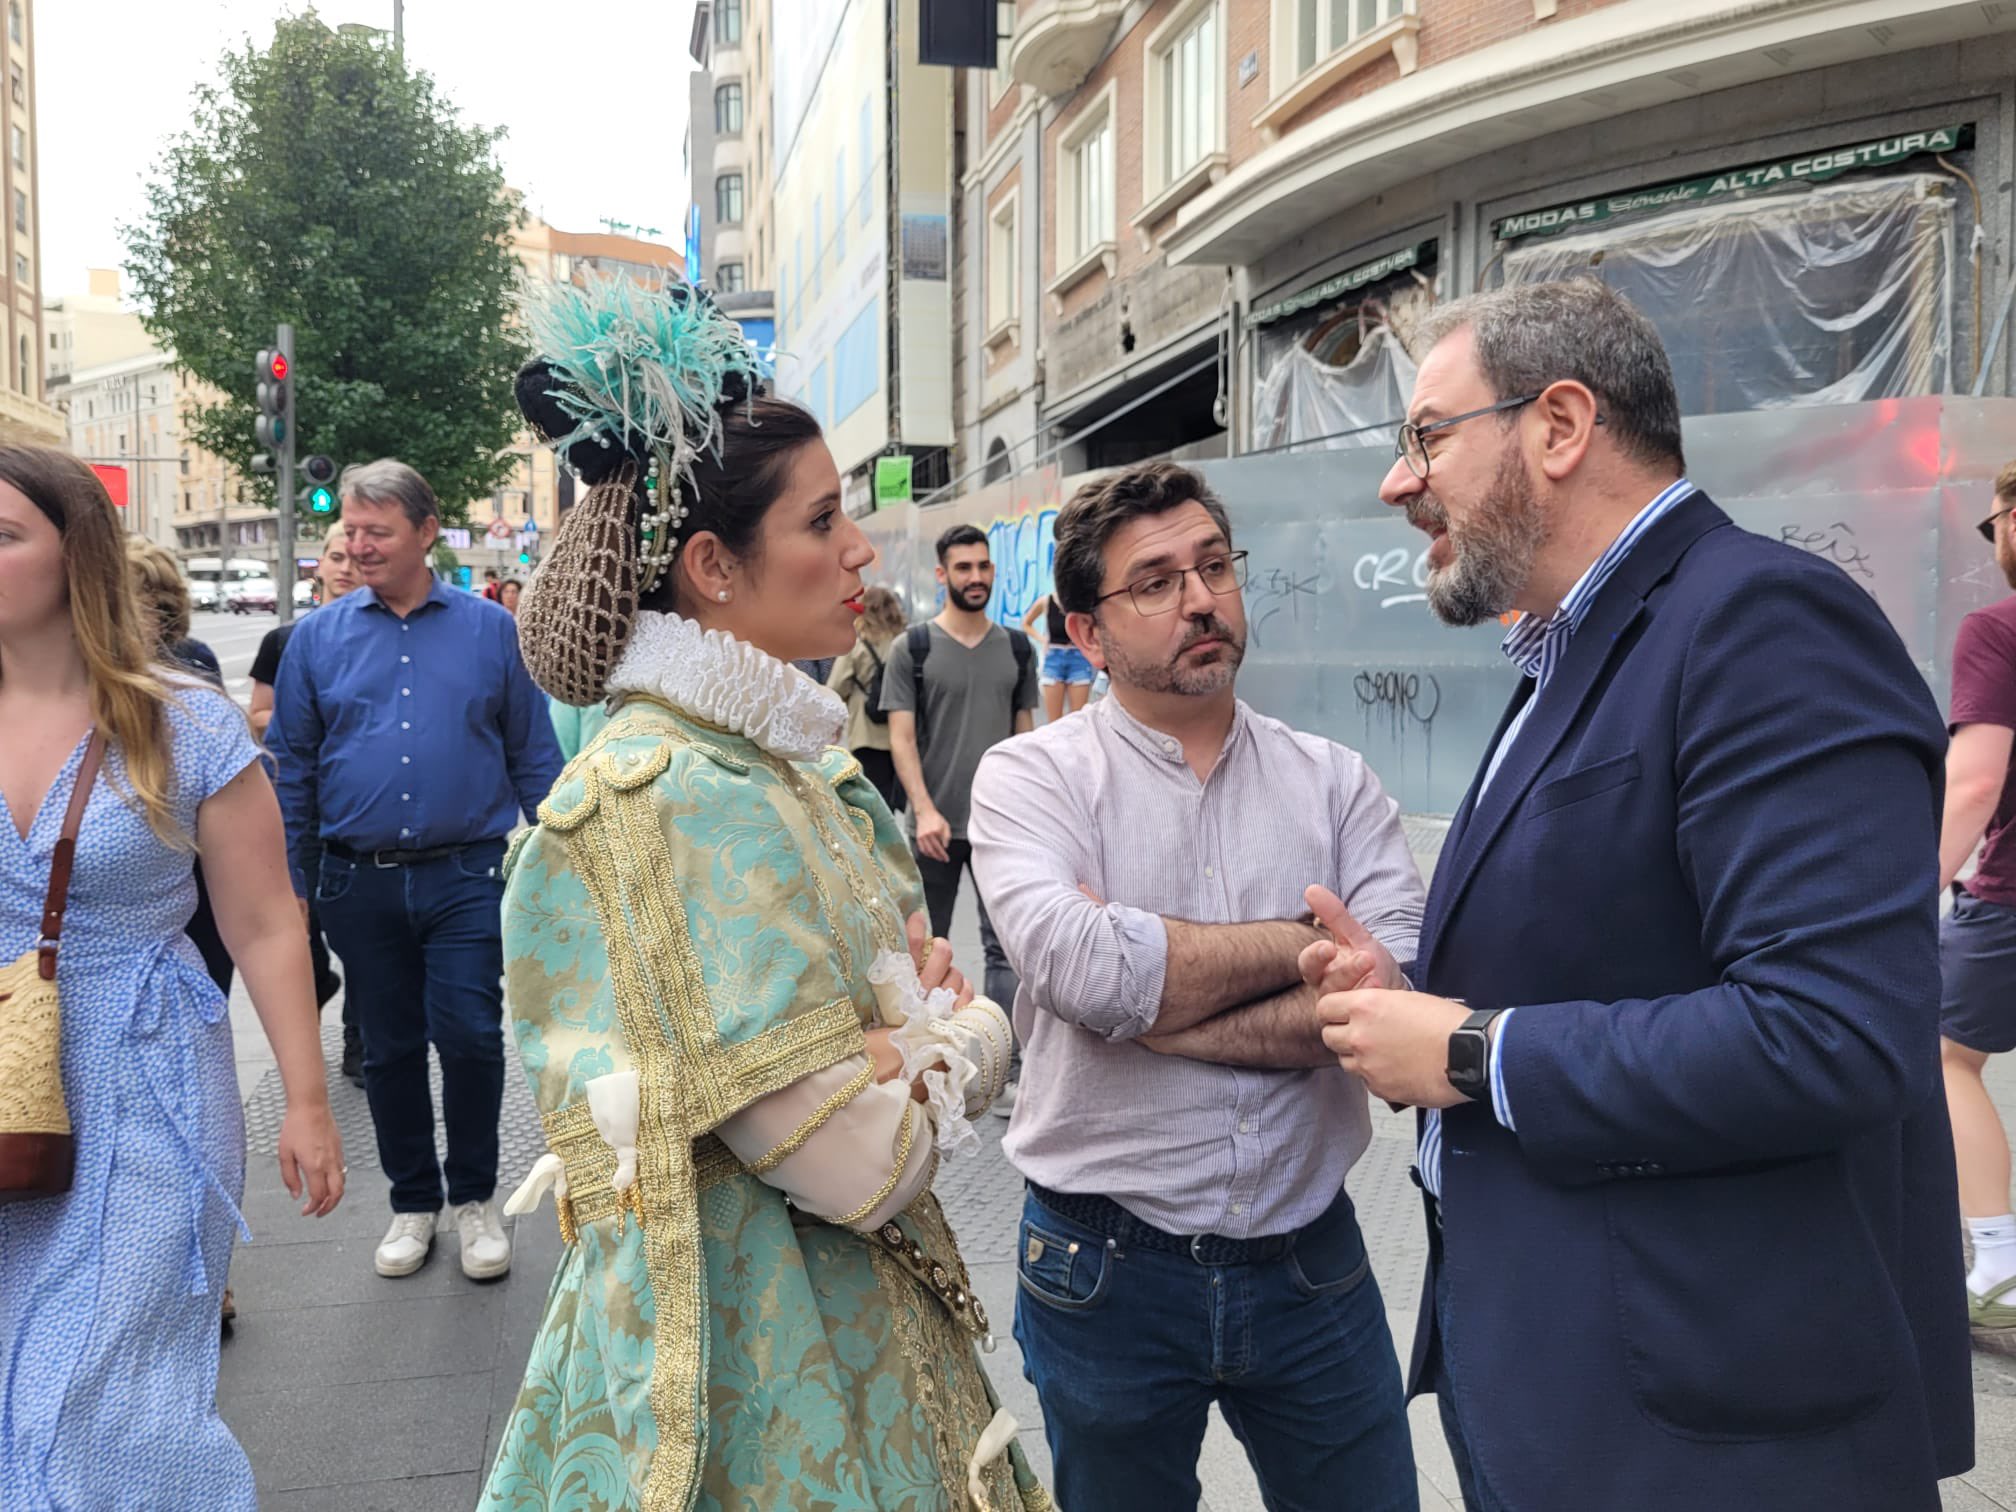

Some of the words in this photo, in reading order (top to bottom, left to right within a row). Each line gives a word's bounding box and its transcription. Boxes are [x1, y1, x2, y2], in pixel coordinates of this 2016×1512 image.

[1504, 203, 1596, 233] MODAS
[1706, 164, 1785, 195] ALTA
[1791, 129, 1951, 178] COSTURA
[1320, 278, 1350, 297] ALTA
[1353, 248, 1413, 285] COSTURA
